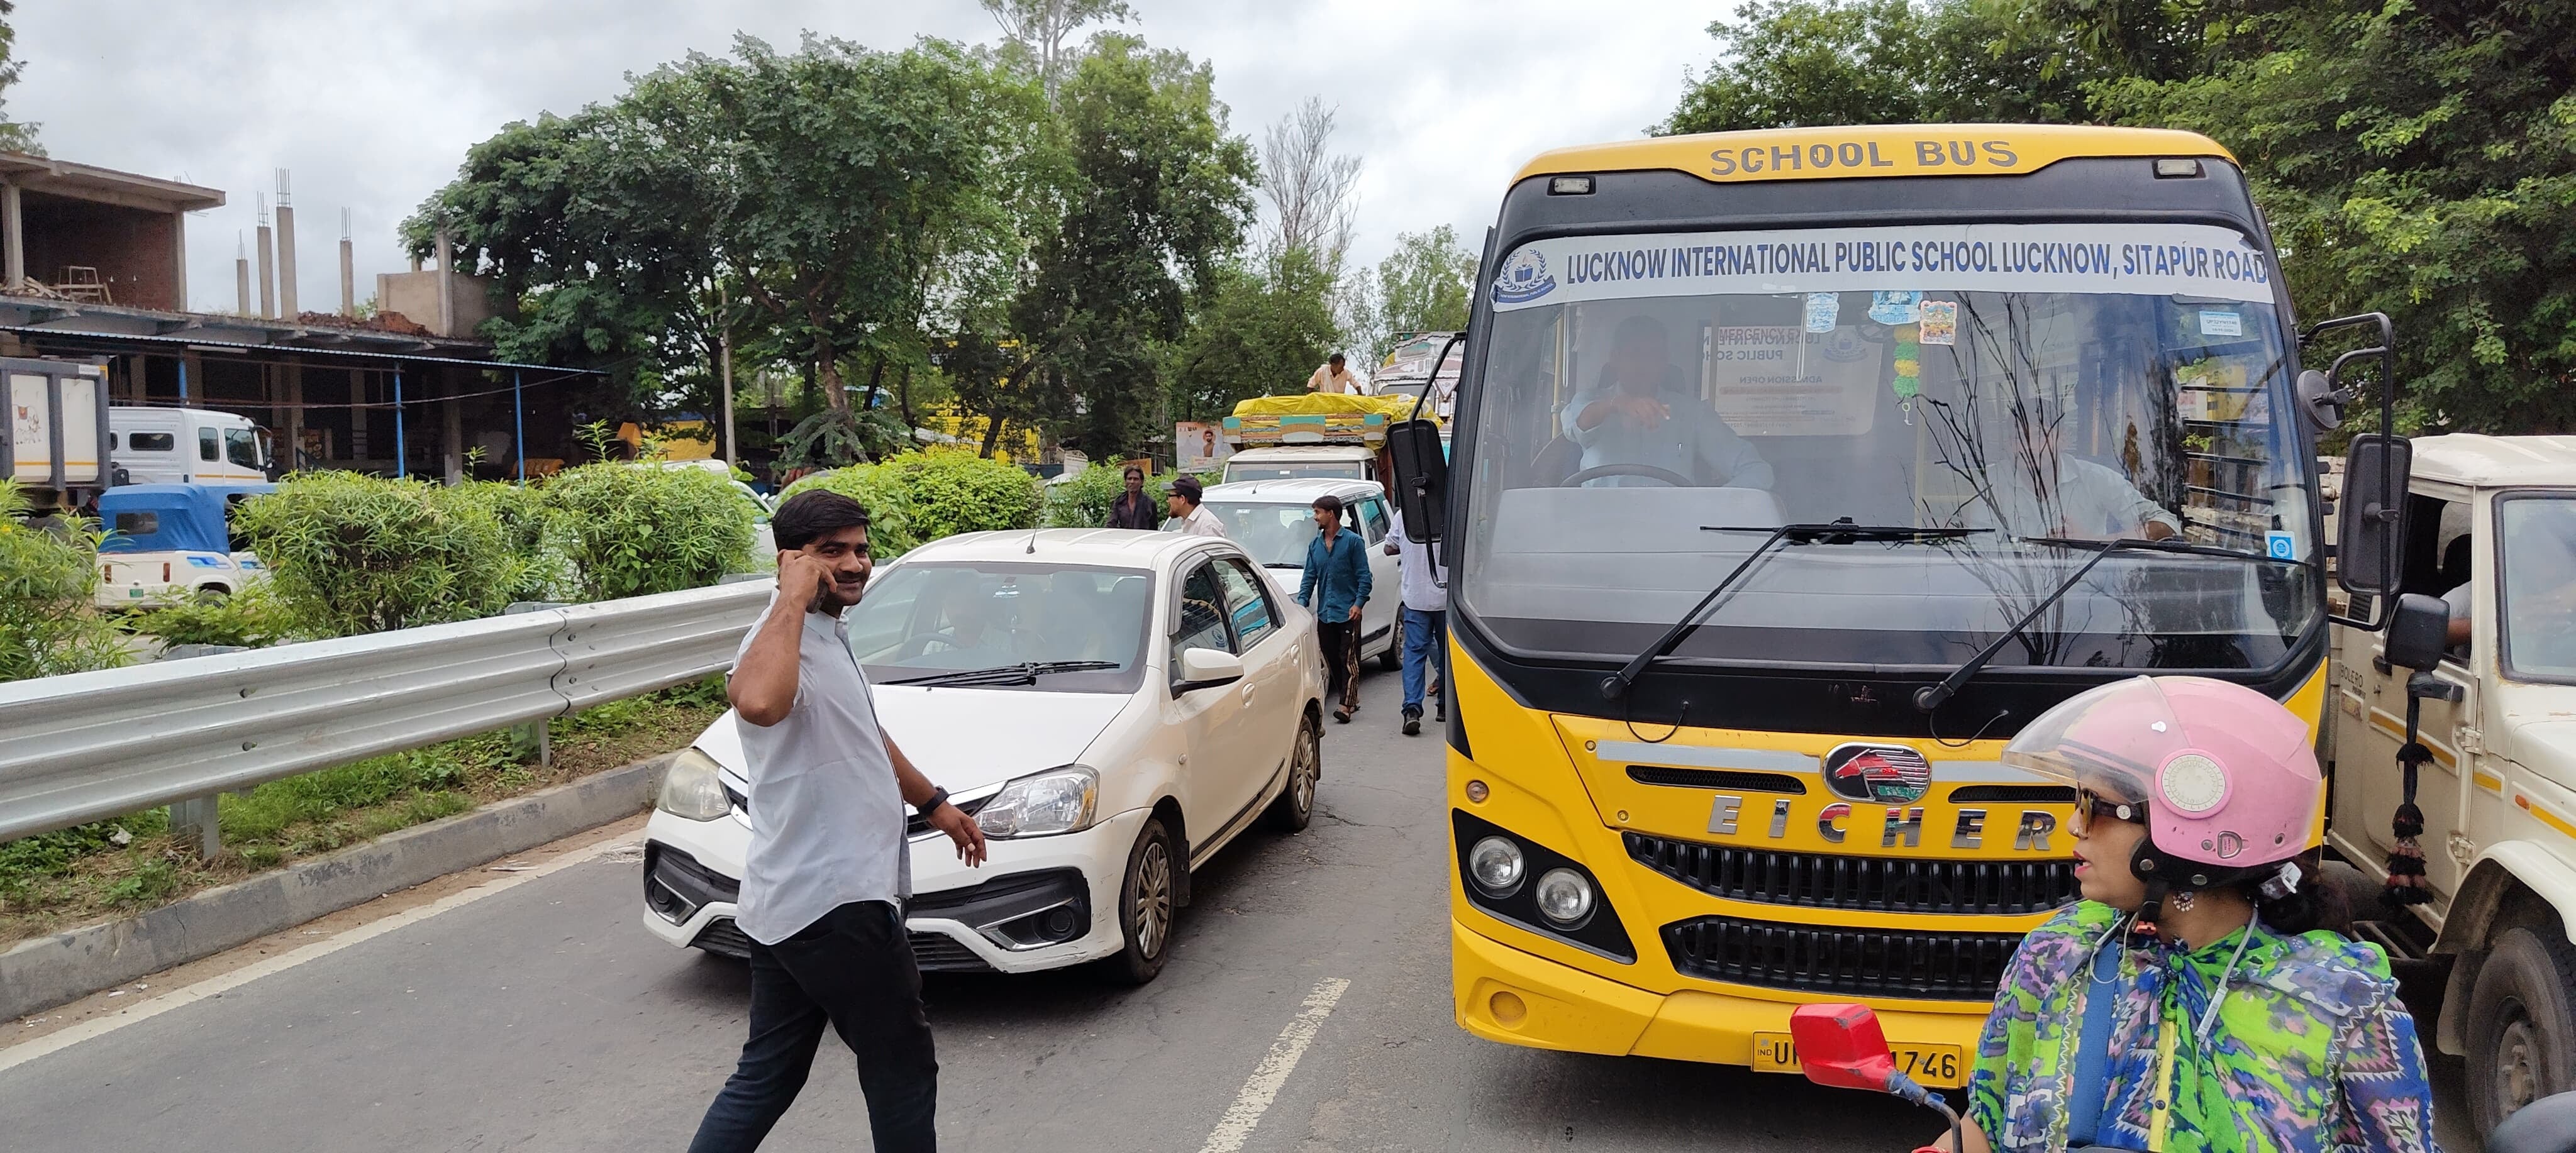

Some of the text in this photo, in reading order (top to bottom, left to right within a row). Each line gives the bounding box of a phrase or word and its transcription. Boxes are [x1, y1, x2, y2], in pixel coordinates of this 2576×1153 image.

[1710, 140, 2018, 176] SCHOOL BUS
[1567, 241, 2267, 284] LUCKNOW INTERNATIONAL PUBLIC SCHOOL LUCKNOW, SITAPUR ROAD
[1707, 795, 2057, 851] EICHER
